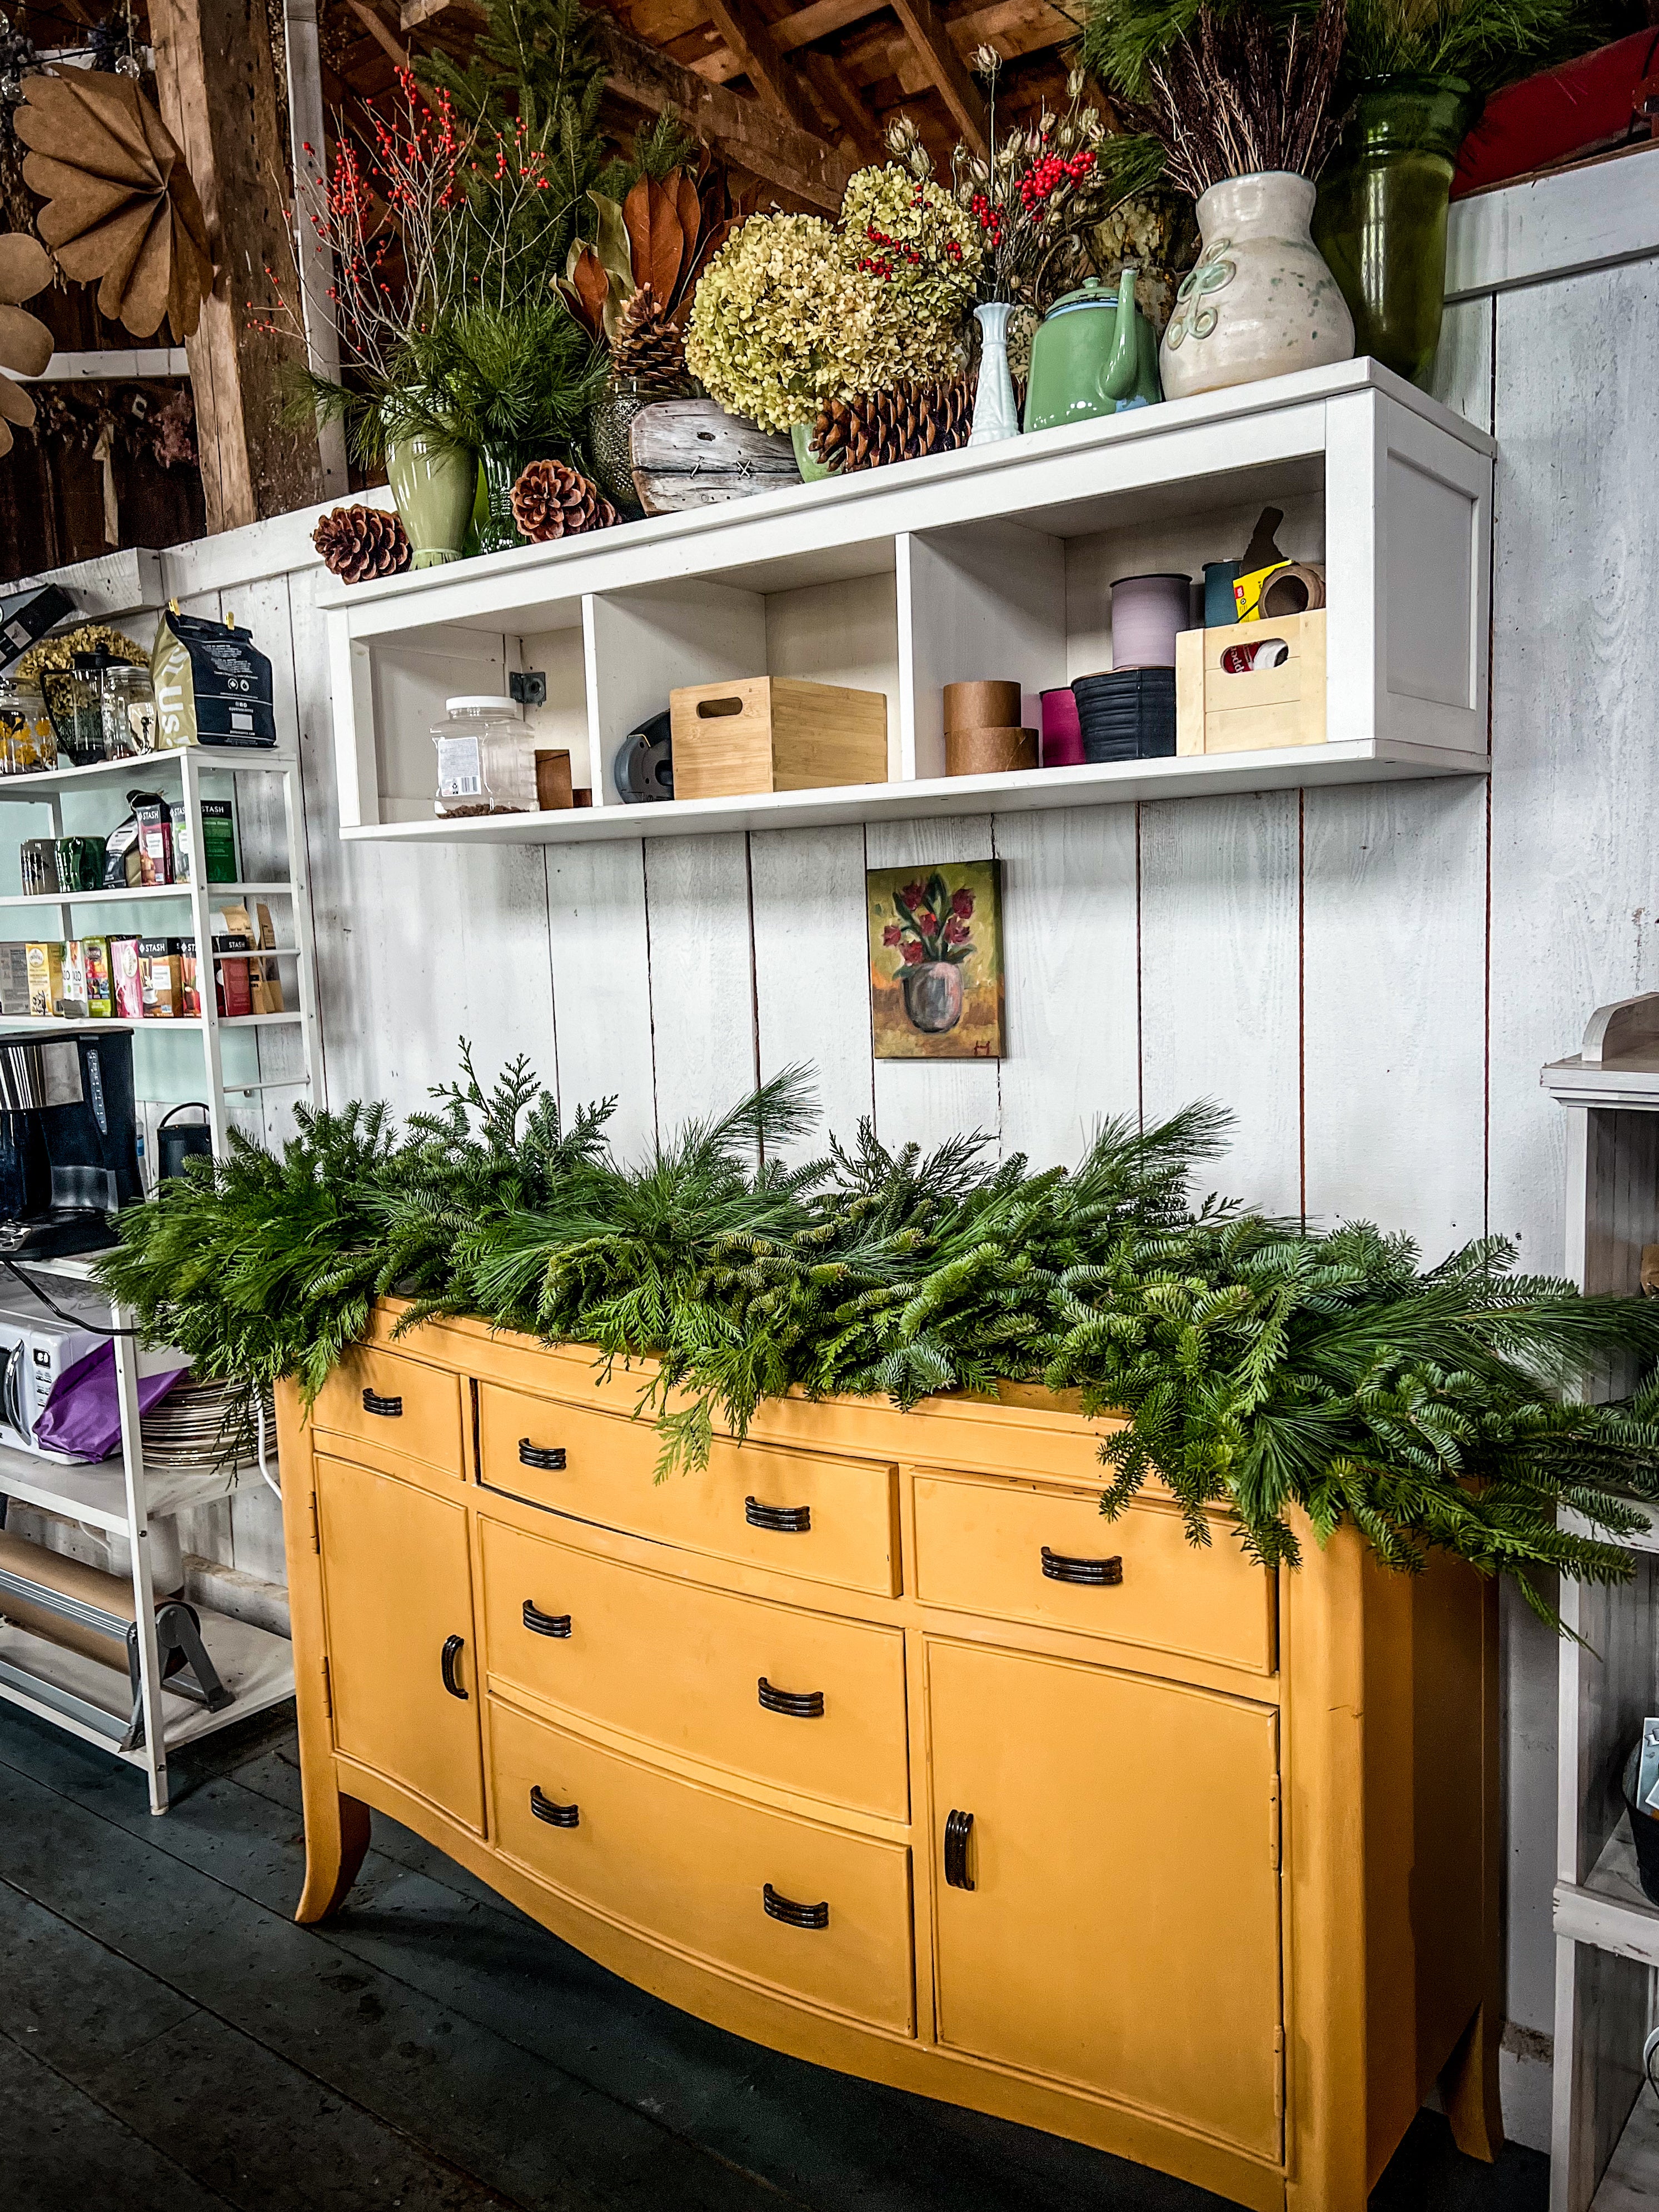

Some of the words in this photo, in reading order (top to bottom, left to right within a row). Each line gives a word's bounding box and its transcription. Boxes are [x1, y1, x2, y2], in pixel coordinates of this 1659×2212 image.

[143, 810, 159, 820] STASH
[174, 807, 185, 816] STAS
[146, 943, 165, 952] STASH
